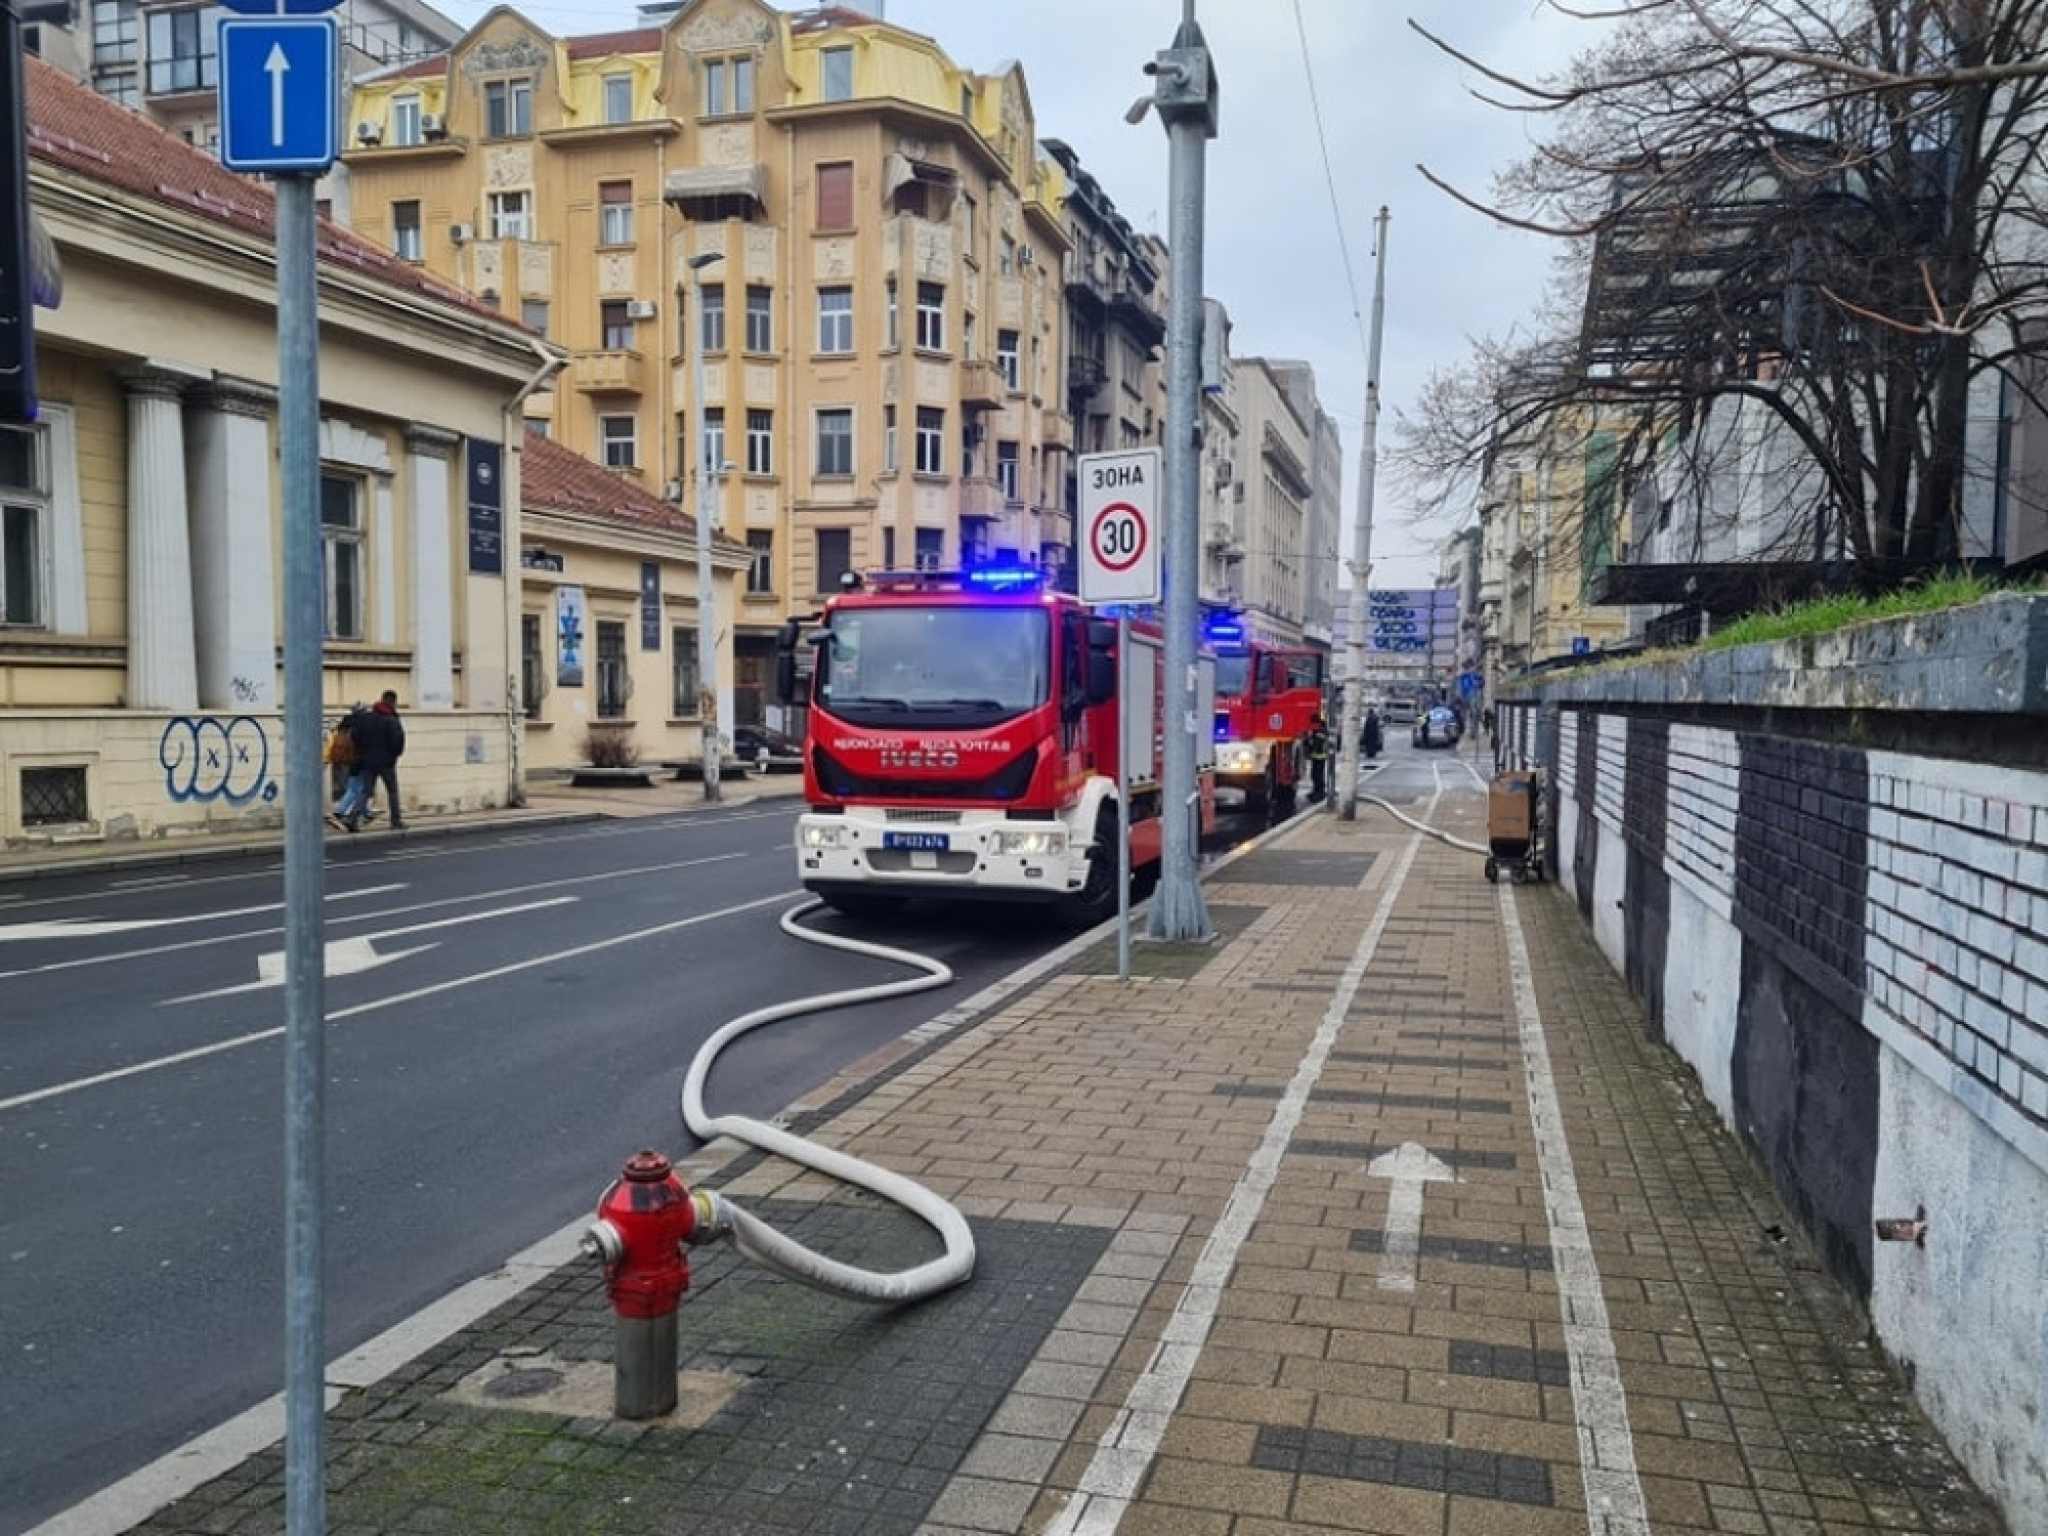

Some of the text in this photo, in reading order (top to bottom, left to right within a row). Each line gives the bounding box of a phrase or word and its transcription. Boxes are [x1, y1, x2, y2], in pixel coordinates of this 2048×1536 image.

[1093, 465, 1144, 489] ЗОНА
[1102, 519, 1135, 555] 30
[880, 751, 959, 768] IVECO
